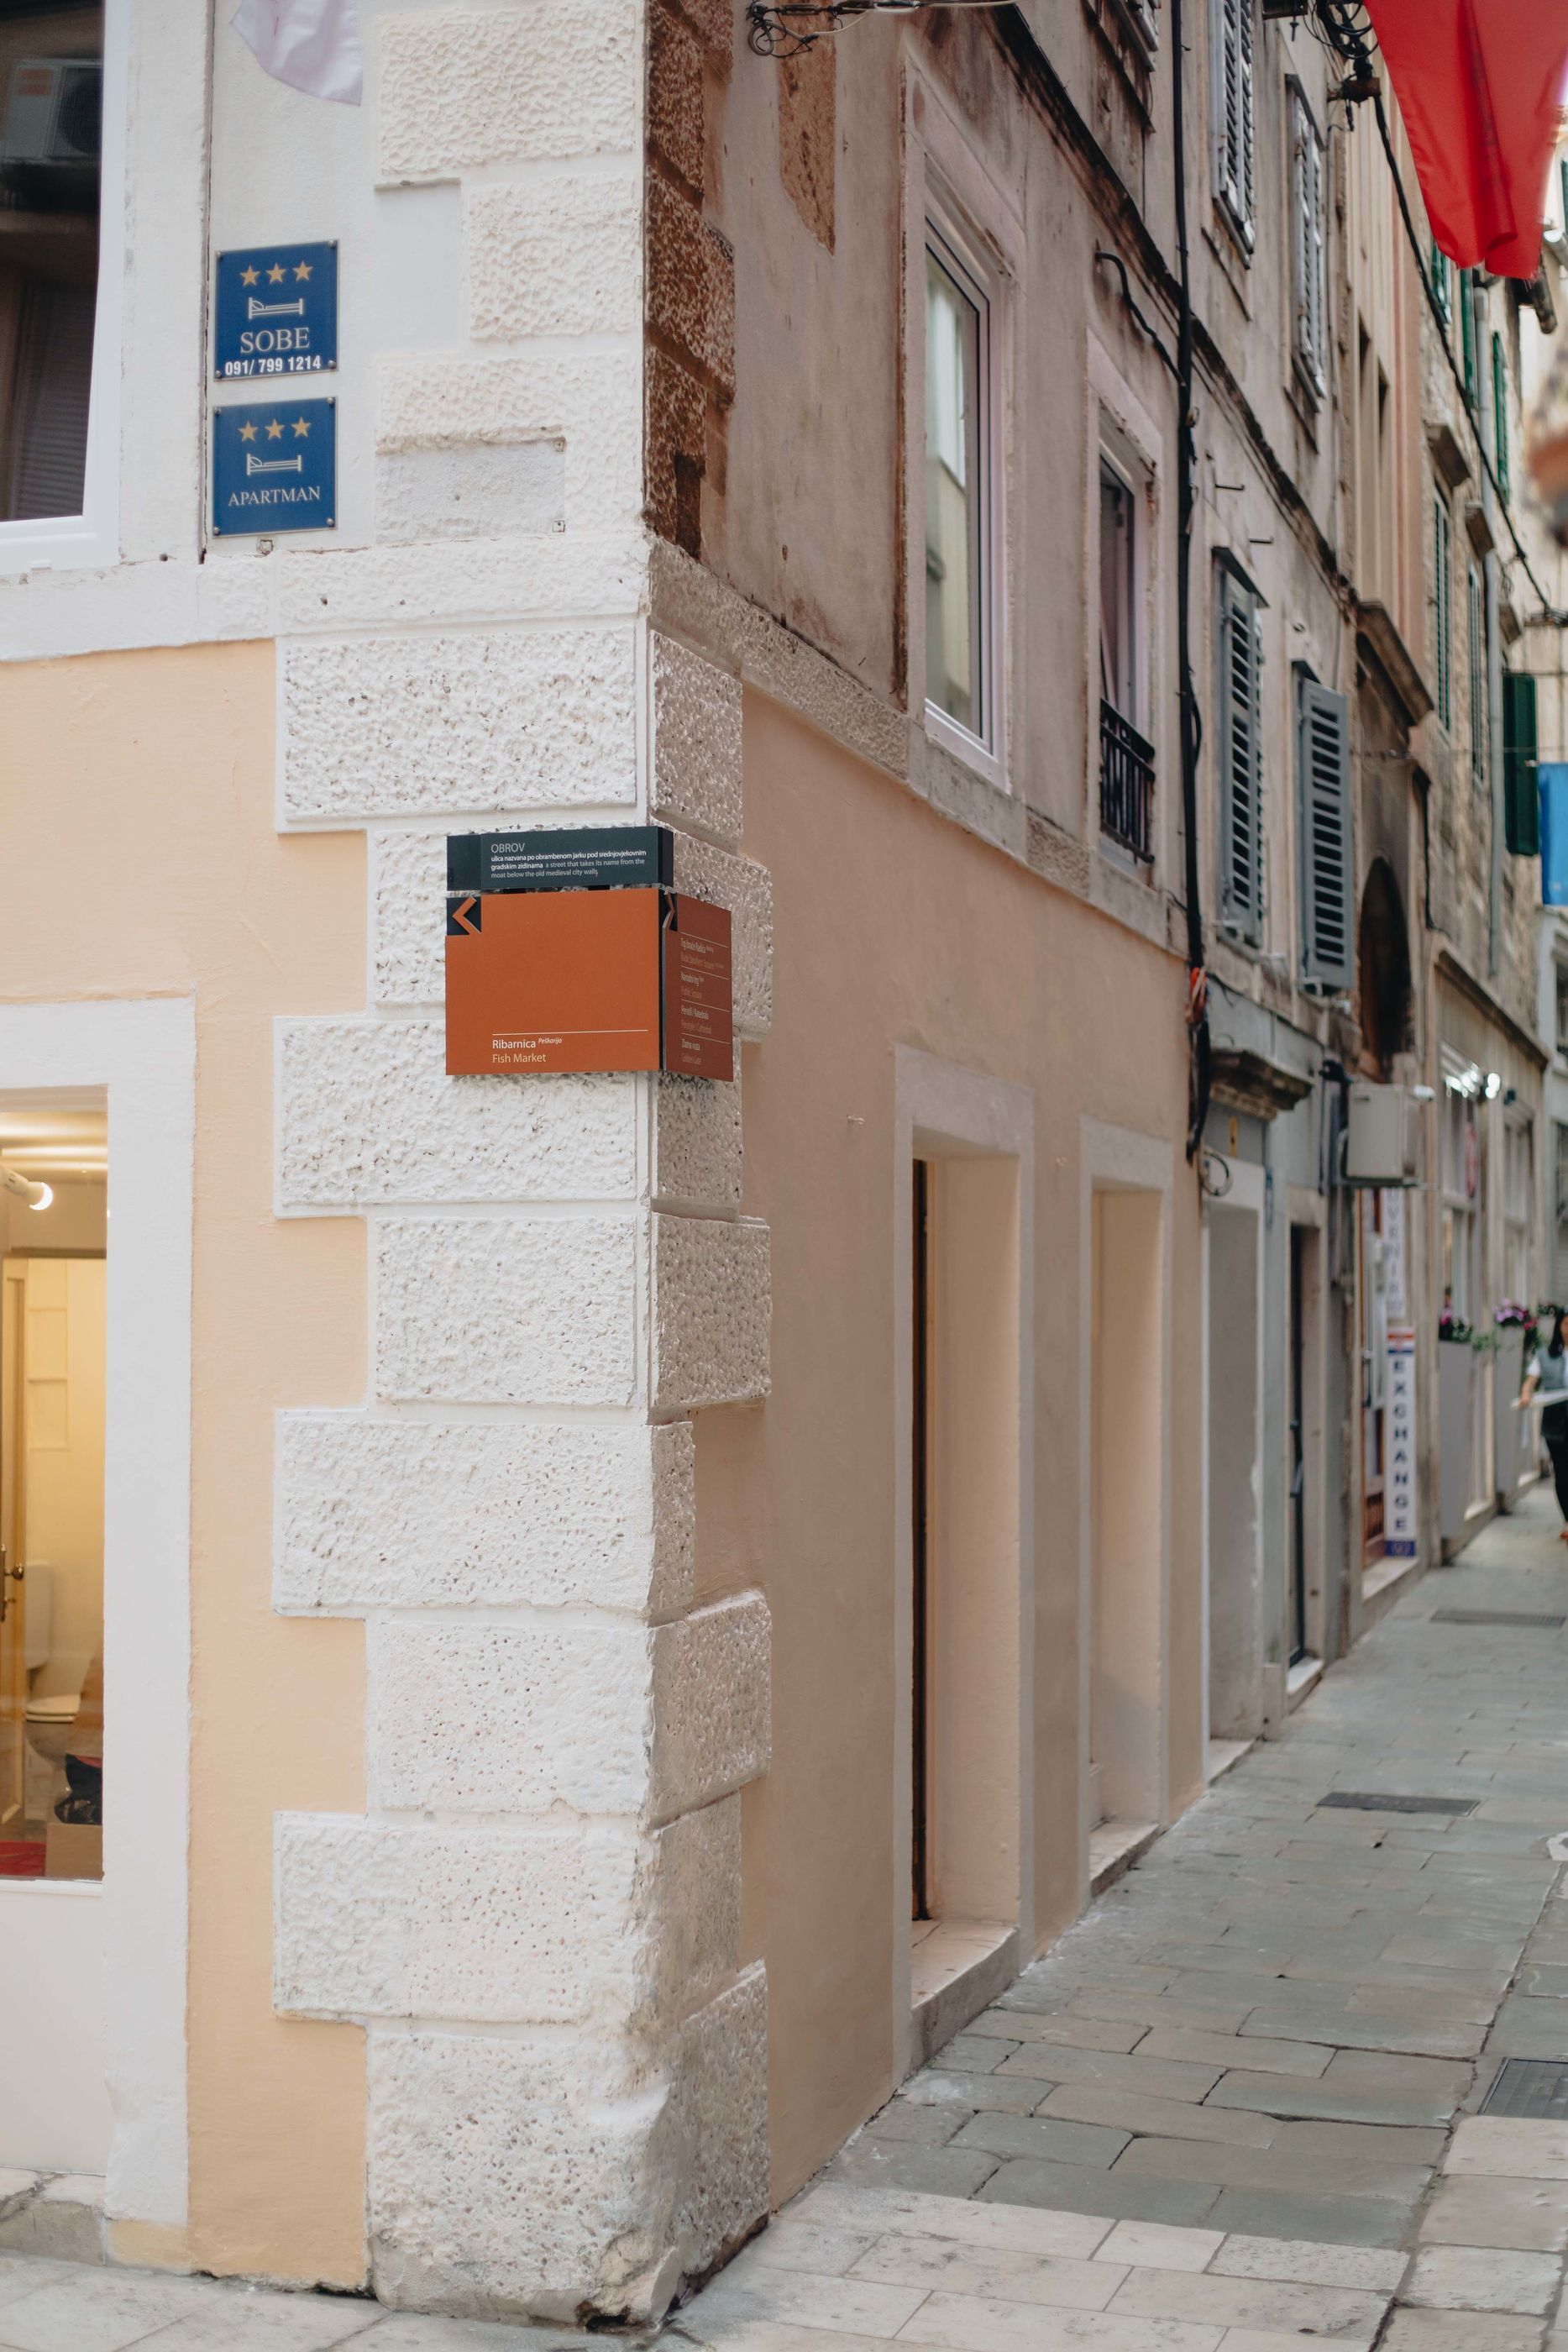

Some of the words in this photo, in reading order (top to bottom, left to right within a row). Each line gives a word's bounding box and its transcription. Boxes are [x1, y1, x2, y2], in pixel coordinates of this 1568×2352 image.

[240, 327, 310, 354] SOBE
[225, 359, 254, 375] 091/
[259, 358, 283, 373] 799
[288, 354, 321, 370] 1214
[228, 486, 321, 507] APARTMAN
[490, 843, 526, 853] OBROV
[587, 851, 599, 859] pod
[599, 849, 647, 858] srednjovjekovnim
[492, 1039, 536, 1049] Ribarnica
[492, 1053, 511, 1063] Fish
[513, 1053, 547, 1063] Market
[1393, 1359, 1408, 1532] EXCHANGE
